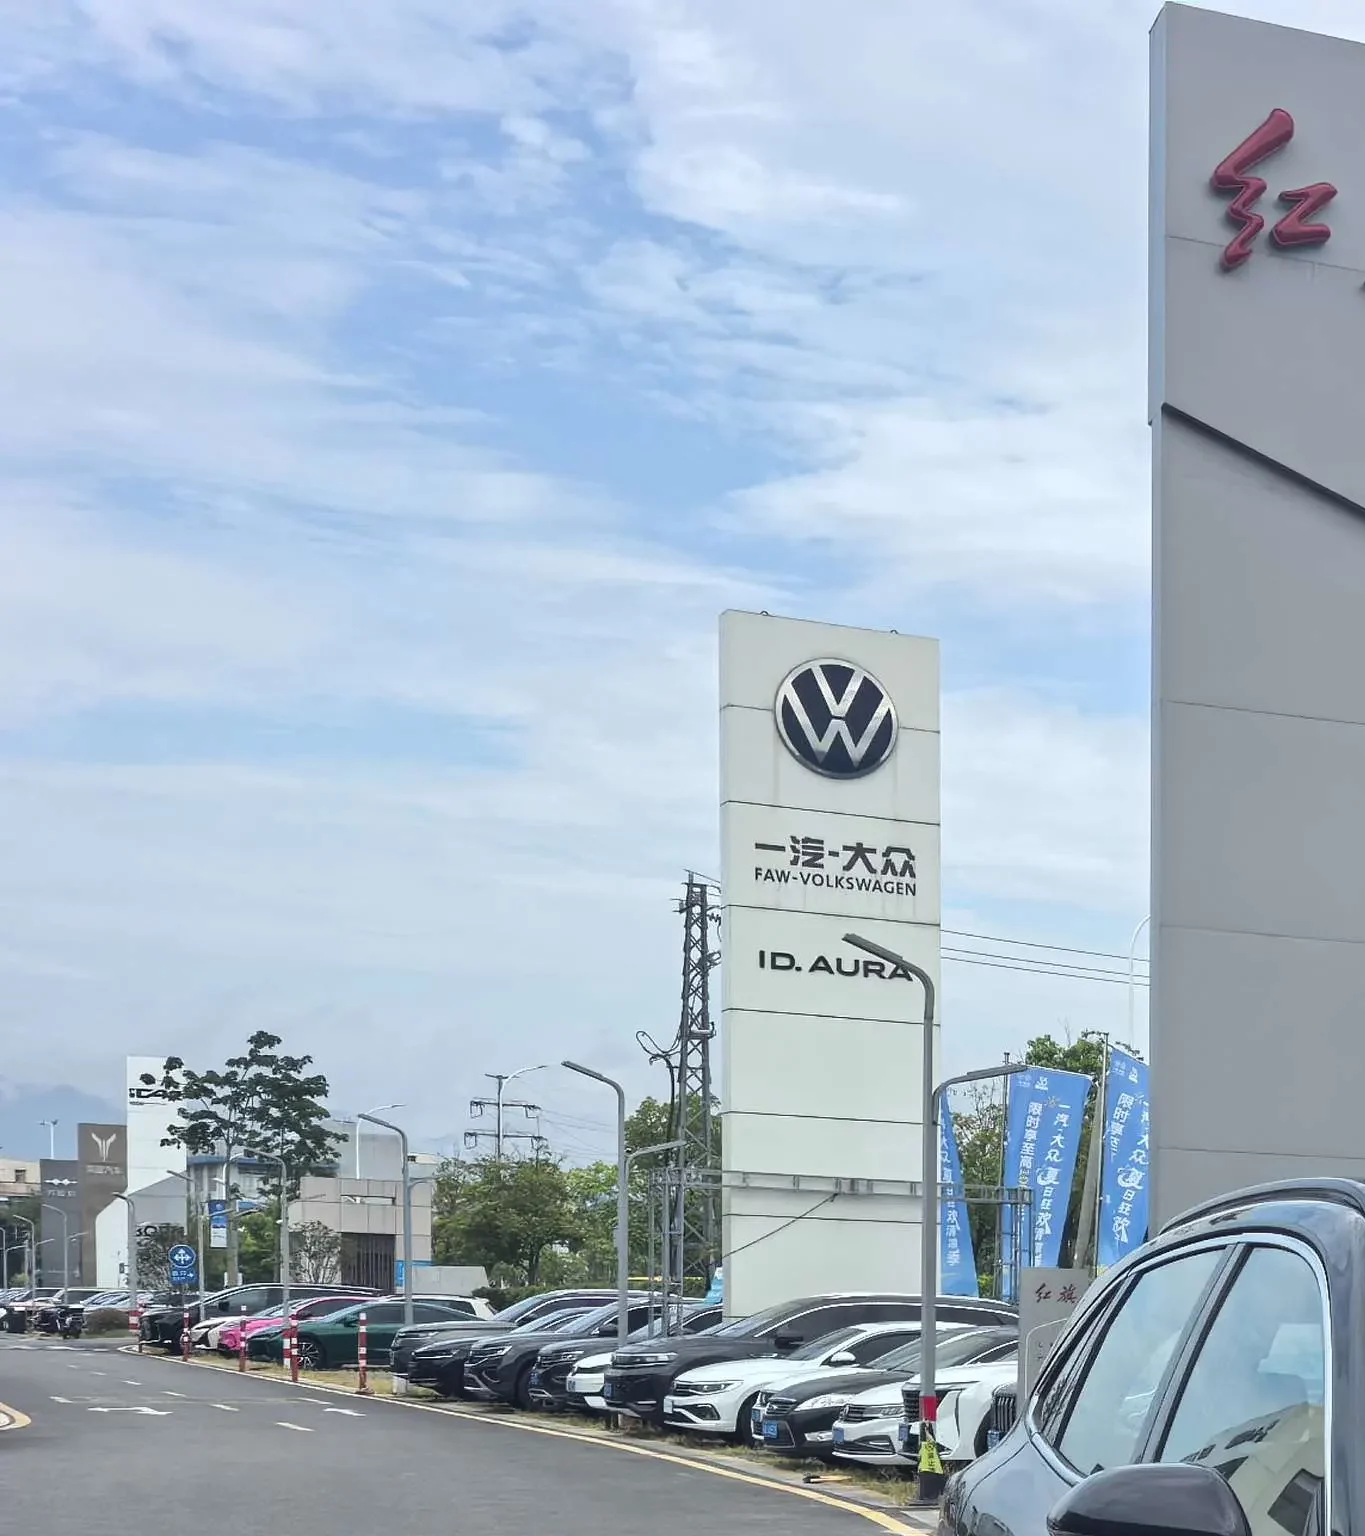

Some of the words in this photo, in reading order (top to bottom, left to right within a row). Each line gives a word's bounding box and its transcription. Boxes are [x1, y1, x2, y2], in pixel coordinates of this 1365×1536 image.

[754, 867, 916, 897] FAW-VOLKSWAGEN
[759, 950, 802, 972] ID.
[809, 955, 913, 981] AURA
